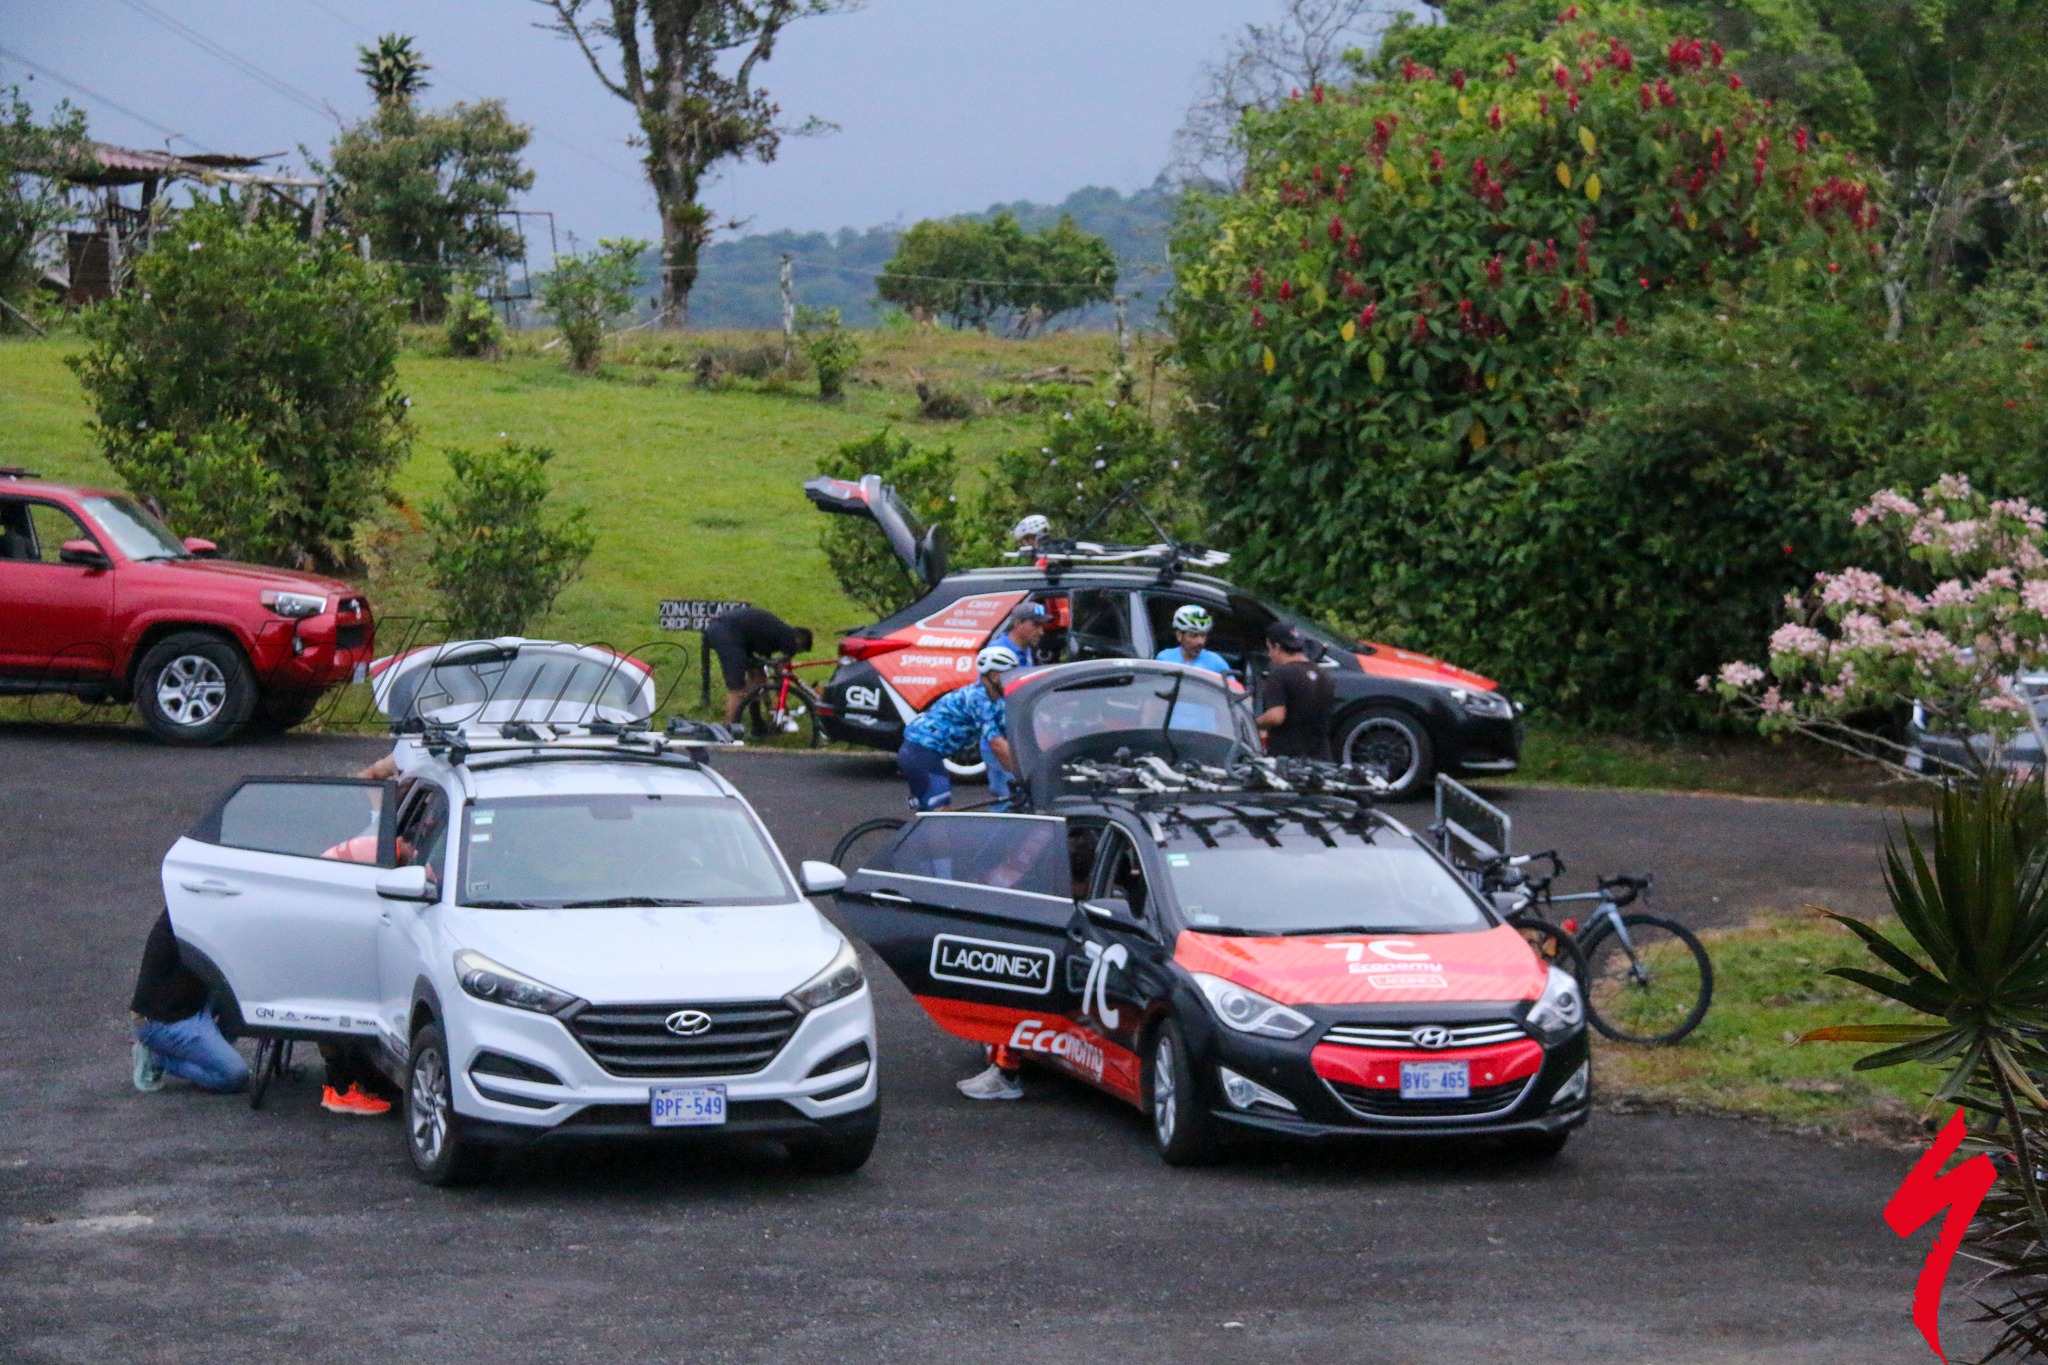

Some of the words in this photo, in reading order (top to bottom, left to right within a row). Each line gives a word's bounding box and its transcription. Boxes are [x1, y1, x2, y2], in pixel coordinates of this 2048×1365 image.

[660, 601, 691, 616] ZONA
[691, 602, 707, 617] DE
[660, 617, 689, 630] DROP
[941, 945, 1043, 980] LACOINEX
[1347, 962, 1444, 974] Economy
[1402, 1070, 1466, 1090] BVG-465
[655, 1096, 723, 1117] BPF-549
